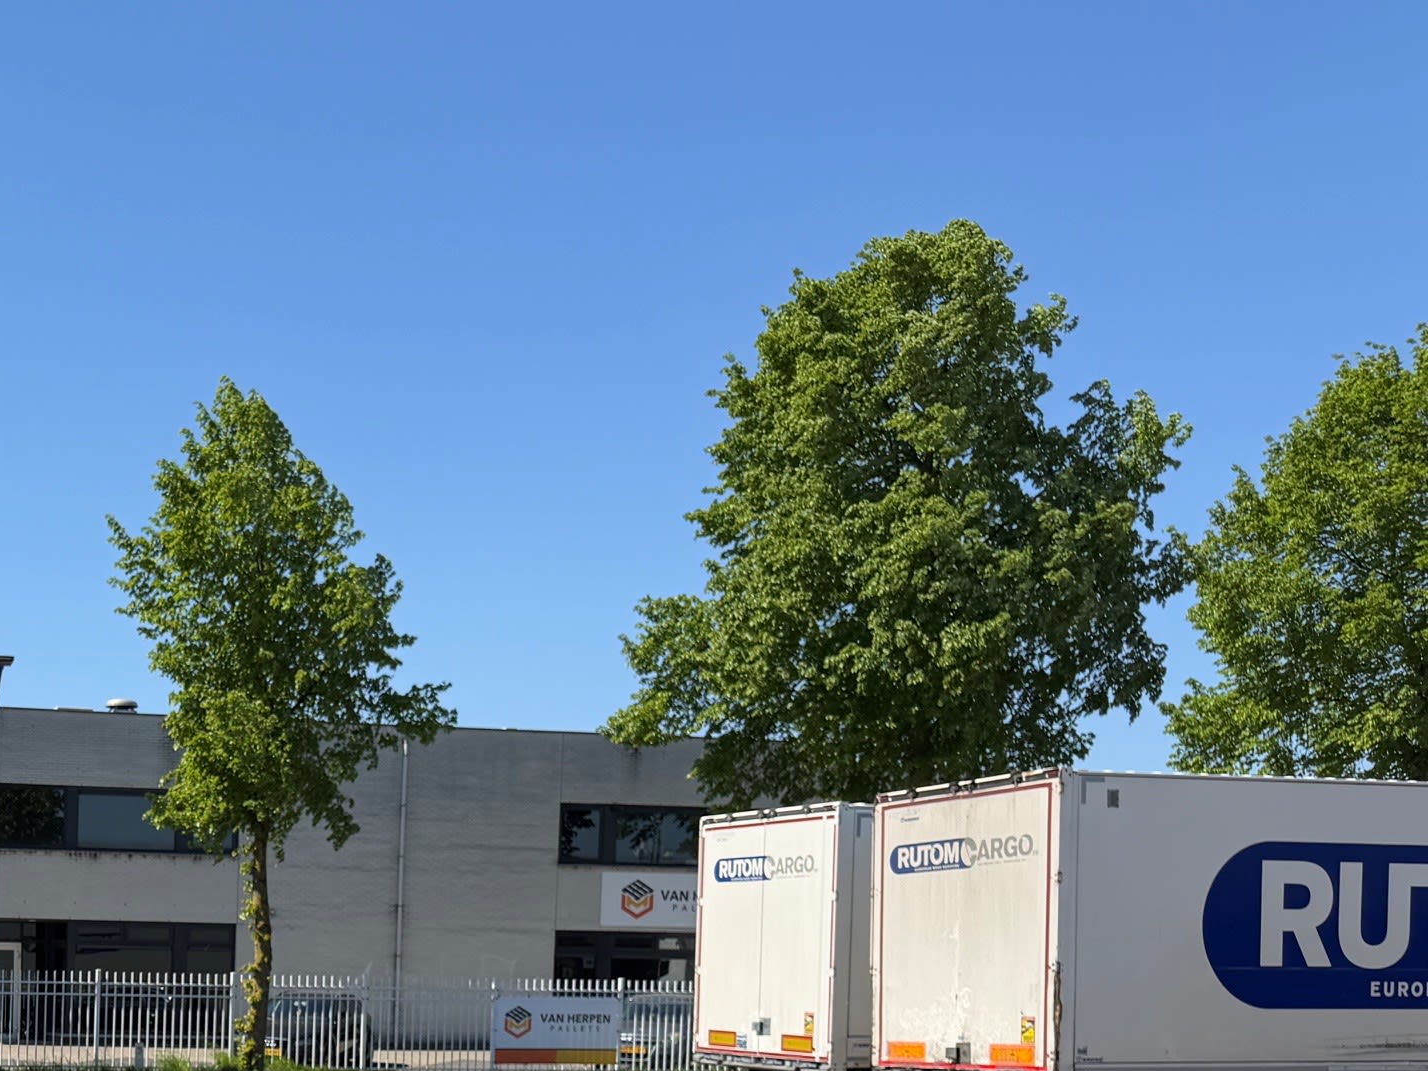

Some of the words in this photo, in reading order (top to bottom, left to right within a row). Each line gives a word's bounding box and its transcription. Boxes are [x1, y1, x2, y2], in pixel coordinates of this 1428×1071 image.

[660, 890, 689, 901] VAN
[1370, 980, 1428, 997] EURO
[540, 1013, 564, 1023] VAN
[567, 1014, 611, 1024] HERPEN
